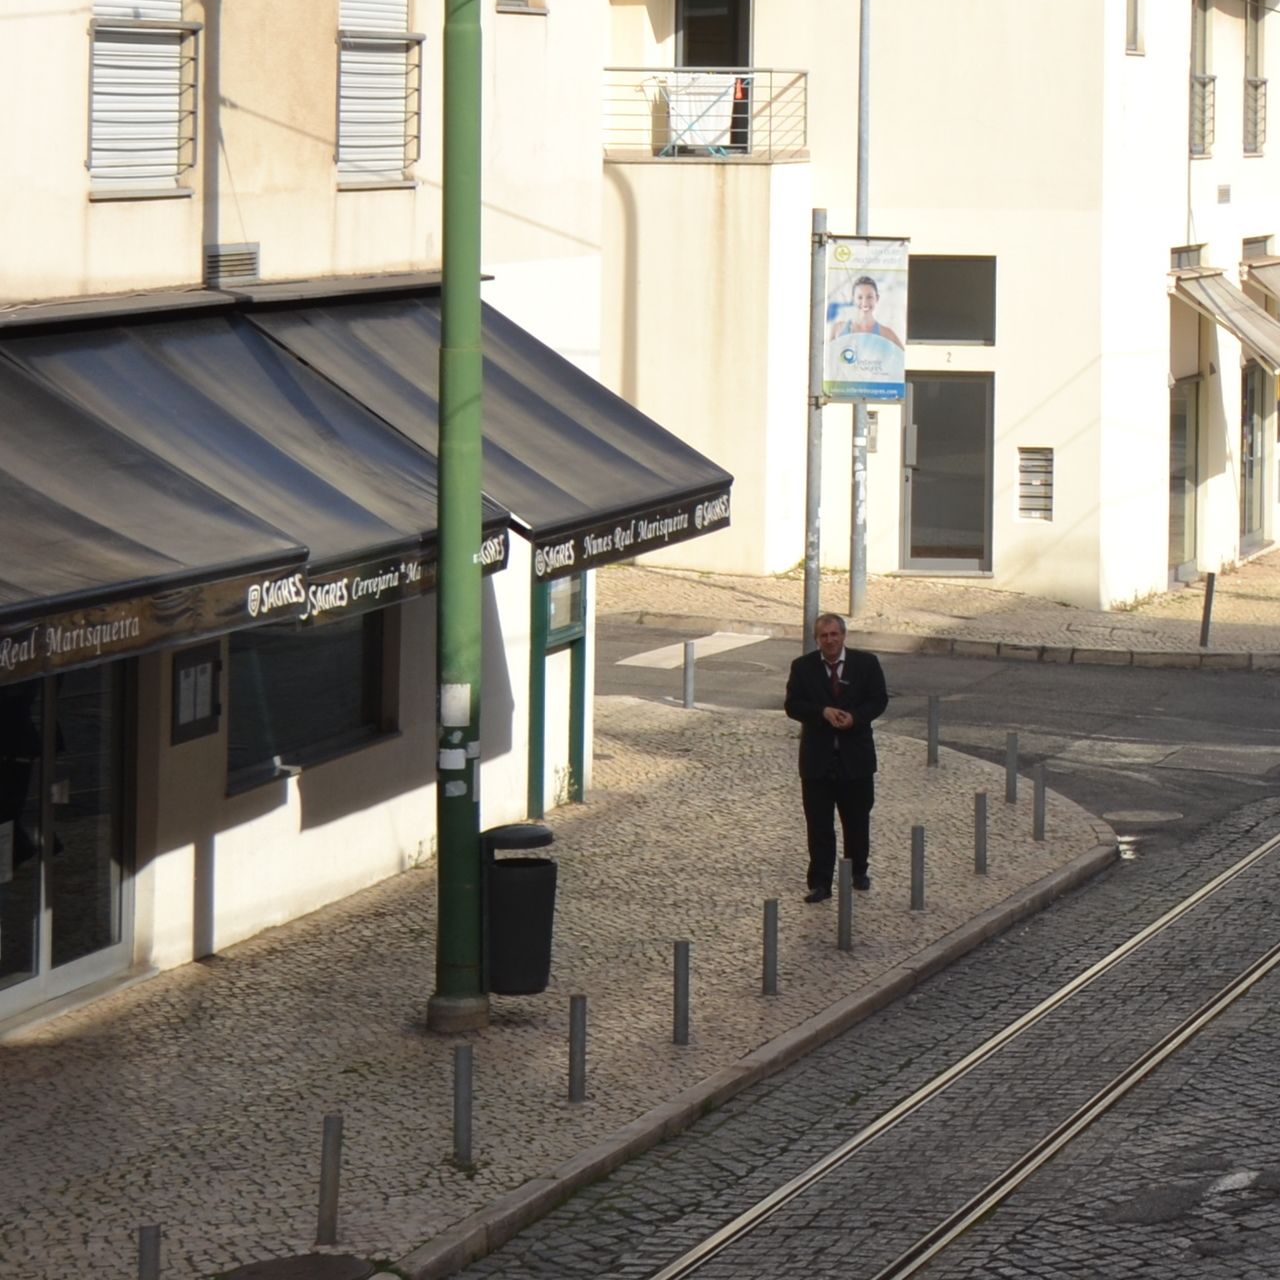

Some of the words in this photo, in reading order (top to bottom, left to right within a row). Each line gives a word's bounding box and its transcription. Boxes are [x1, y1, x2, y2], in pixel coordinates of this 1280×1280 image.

[946, 351, 952, 364] 2
[544, 540, 575, 573] SAGRES
[583, 534, 612, 559] Nunes
[613, 520, 635, 551] Real
[637, 509, 689, 541] Marisqueira
[704, 495, 730, 526] SAGRES
[0, 627, 39, 671] Real
[46, 610, 140, 656] Marisqueira
[260, 573, 306, 614] SAGRES
[309, 578, 349, 617] SAGRES
[352, 565, 399, 600] Cervejaria
